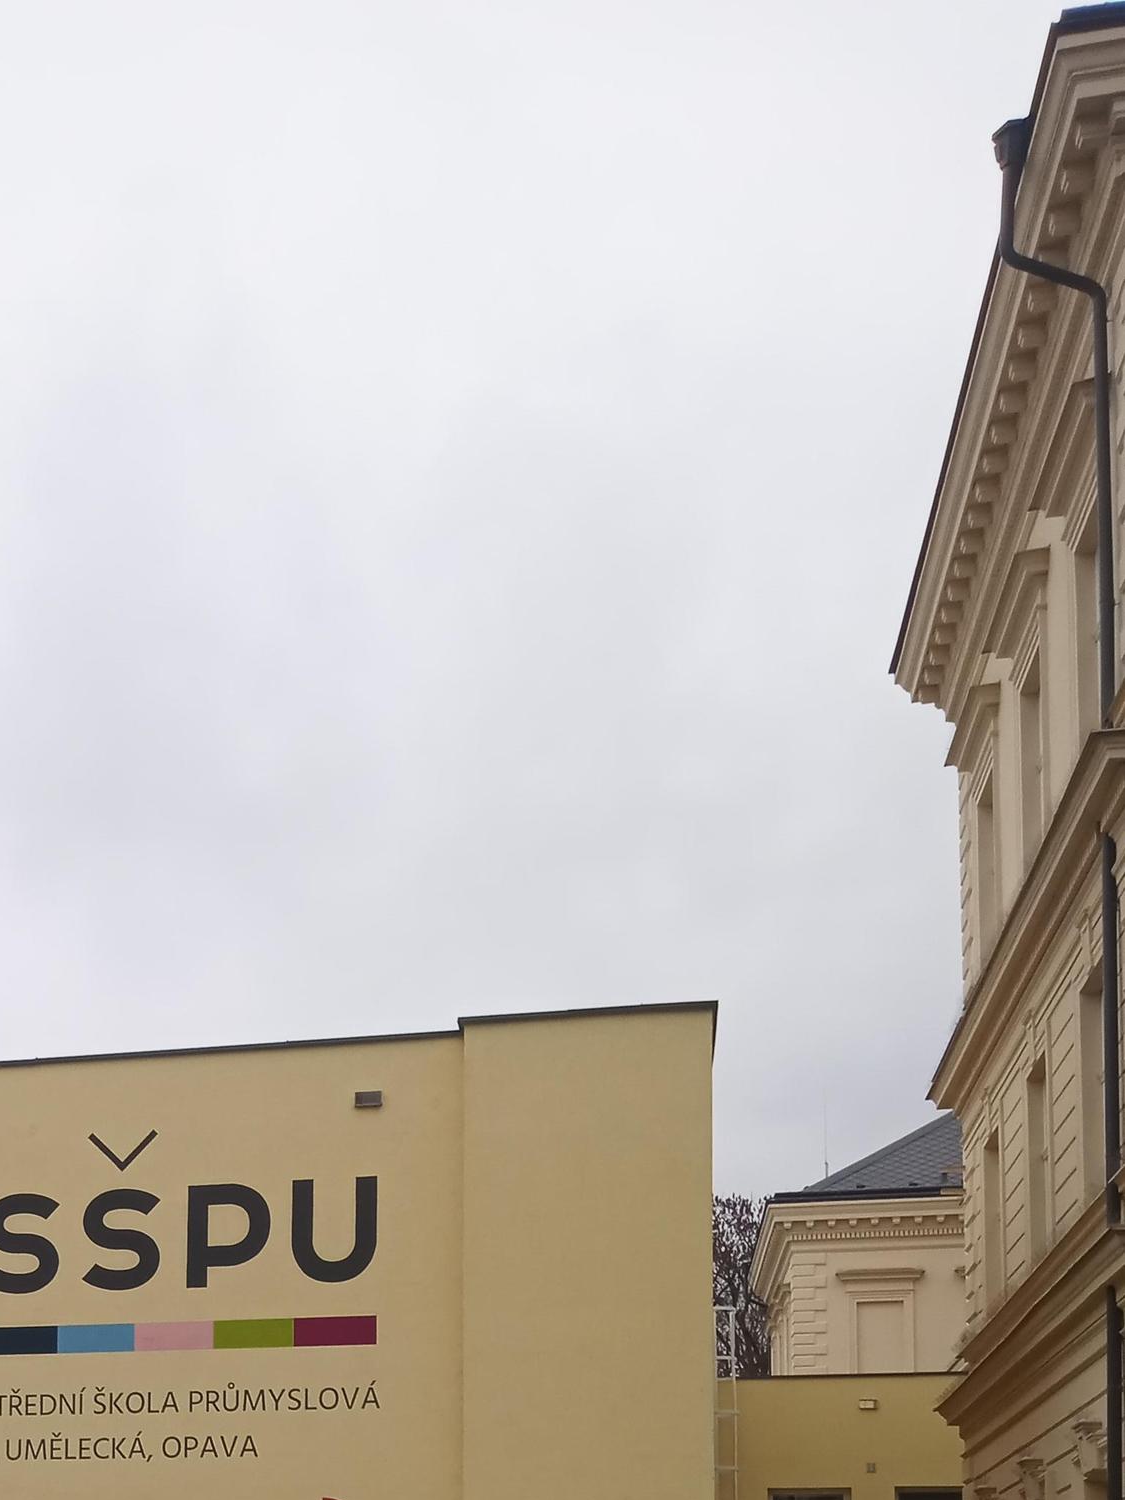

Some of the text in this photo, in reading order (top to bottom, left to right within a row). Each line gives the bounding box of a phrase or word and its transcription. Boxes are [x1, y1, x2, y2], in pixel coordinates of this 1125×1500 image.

[93, 1386, 179, 1415] ŠKOLA
[188, 1380, 380, 1413] PRŮMYSLOVÁ
[5, 1430, 153, 1463] UMĚLECKÁ,
[161, 1435, 259, 1459] OPAVA
